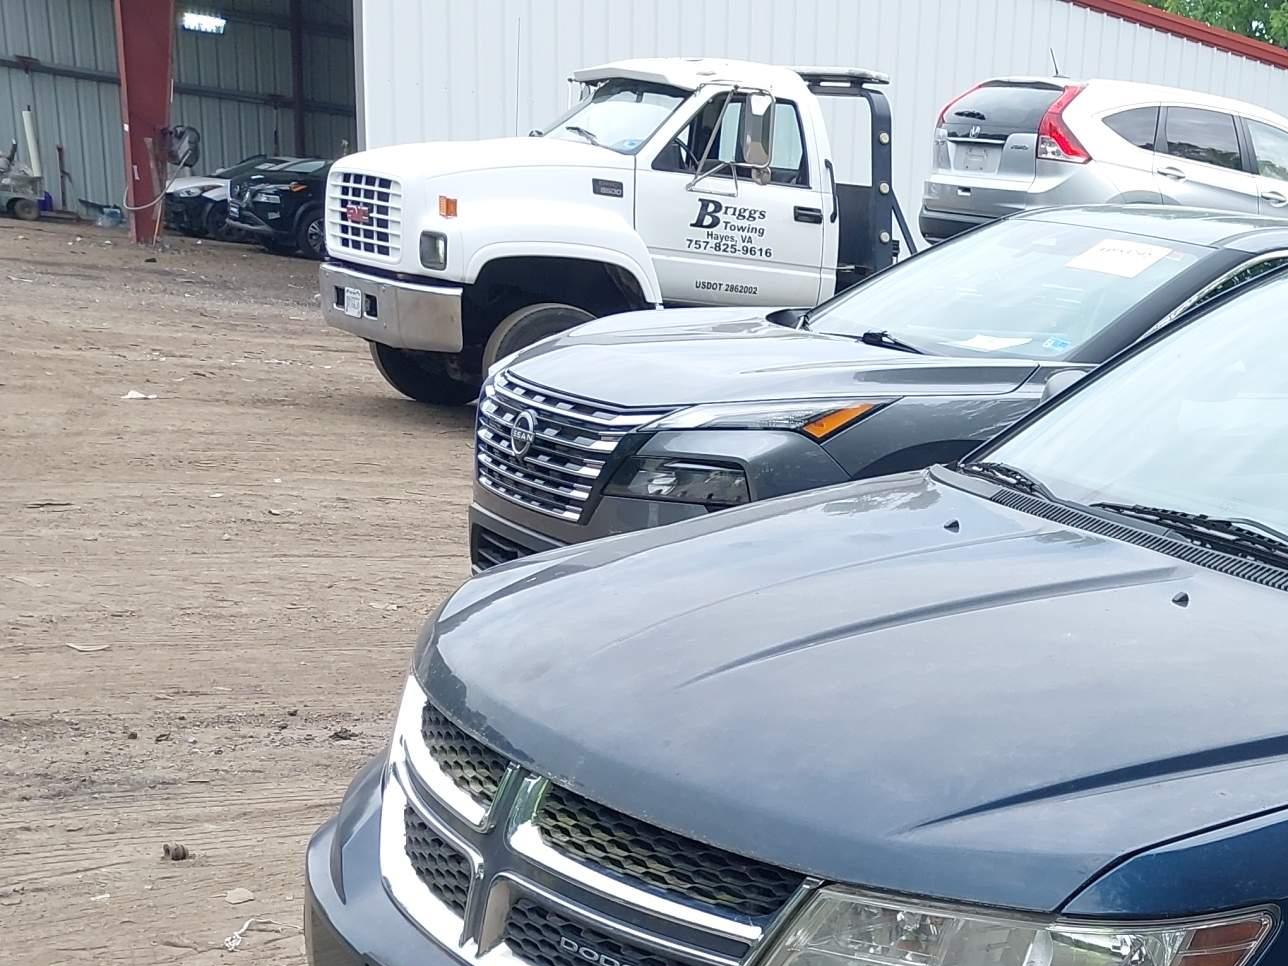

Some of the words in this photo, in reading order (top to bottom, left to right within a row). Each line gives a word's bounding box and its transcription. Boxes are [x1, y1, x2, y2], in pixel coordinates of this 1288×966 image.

[689, 198, 767, 230] Briggs
[723, 221, 765, 237] Towing
[706, 231, 738, 243] Hayes,
[741, 234, 753, 244] VA
[686, 238, 772, 258] 757-825-9616
[695, 280, 723, 292] USDOT
[725, 283, 758, 295] 2862002
